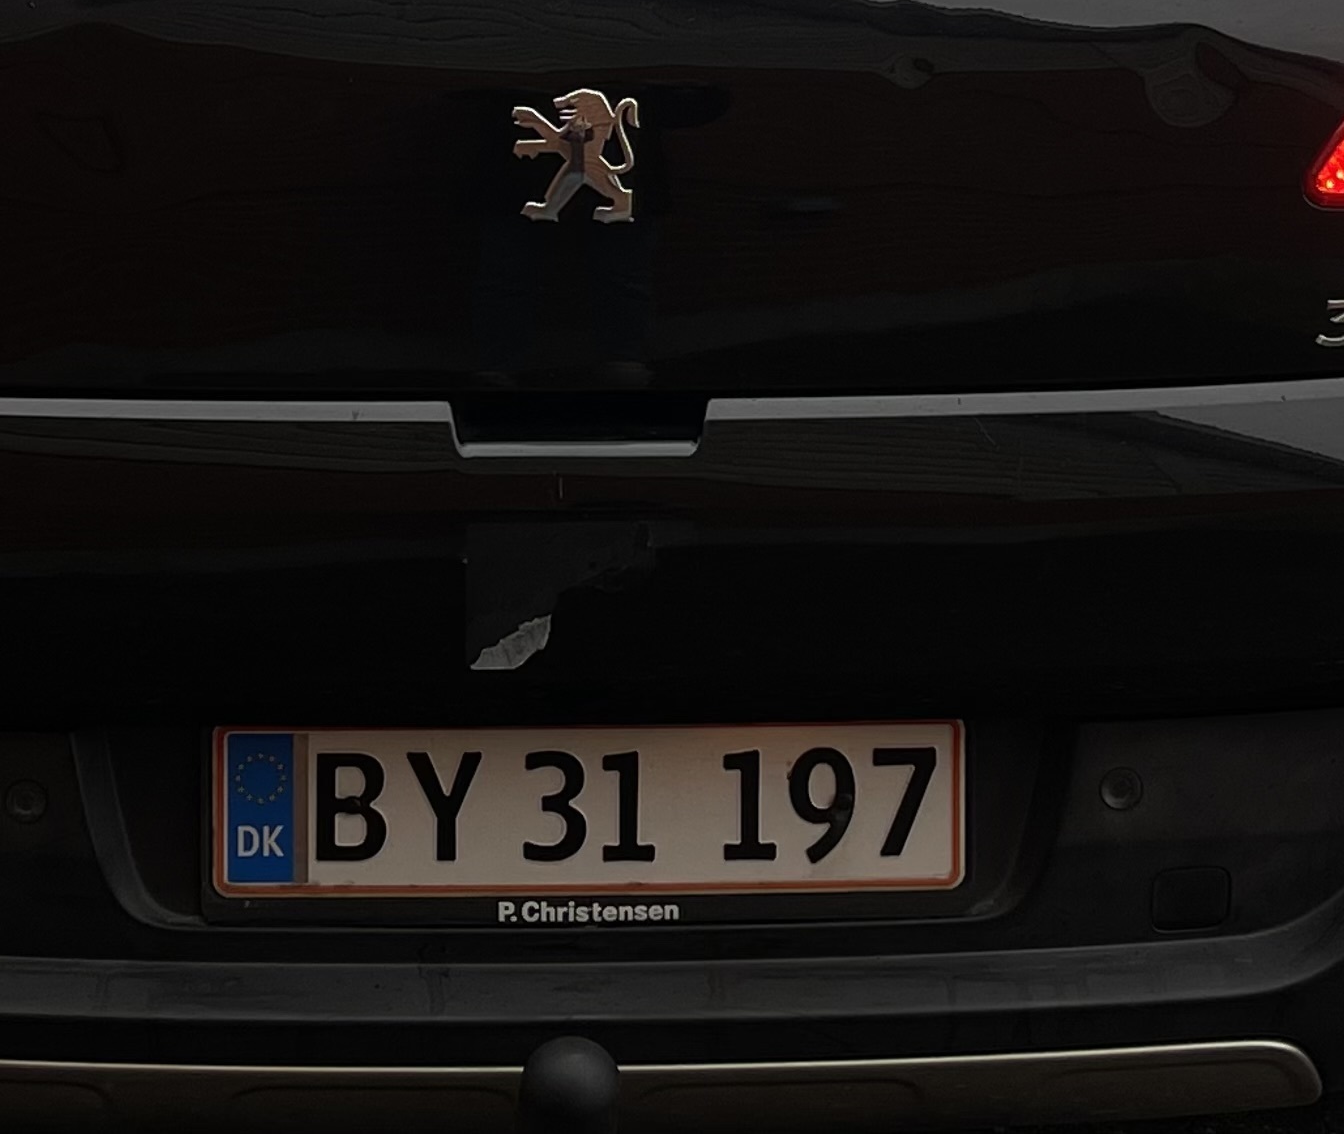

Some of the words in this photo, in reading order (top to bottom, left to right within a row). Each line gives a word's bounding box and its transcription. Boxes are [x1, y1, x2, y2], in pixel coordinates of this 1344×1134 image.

[236, 824, 284, 859] DK
[314, 752, 482, 862] BY
[522, 750, 656, 862] 31
[722, 746, 938, 864] 197
